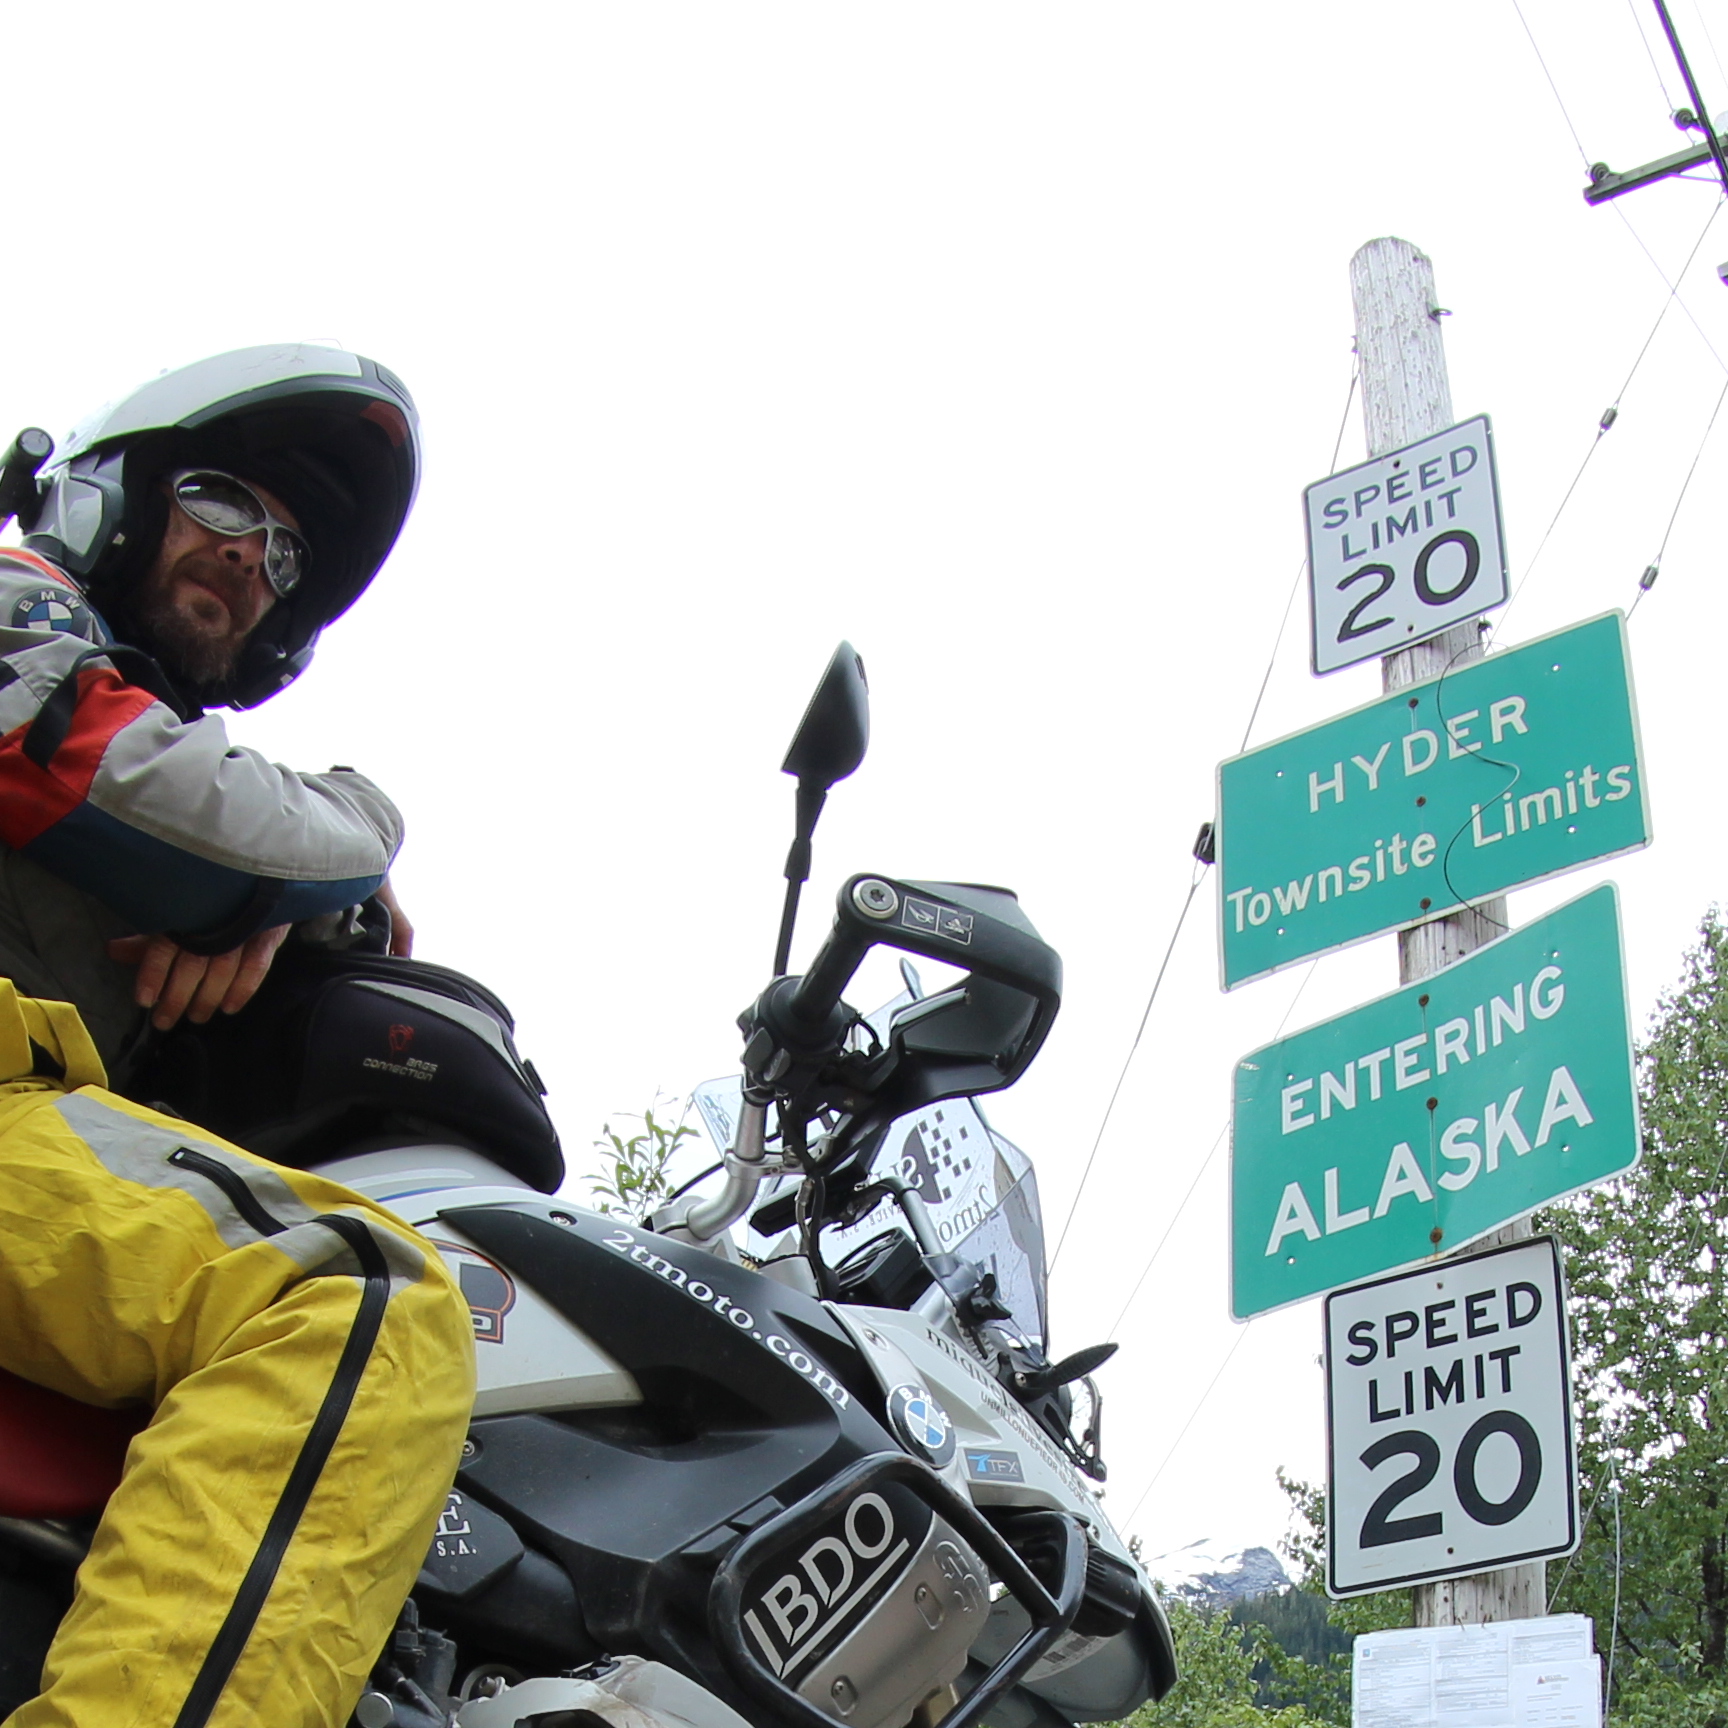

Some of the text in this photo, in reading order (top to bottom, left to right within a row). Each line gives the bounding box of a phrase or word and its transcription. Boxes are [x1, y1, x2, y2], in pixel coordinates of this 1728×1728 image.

[1322, 444, 1479, 530] SPEED
[1341, 486, 1462, 563] LIMIT
[18, 590, 81, 613] BMW
[1336, 529, 1480, 644] 20
[1308, 695, 1528, 813] HYDER
[1226, 763, 1632, 934] Townsite Limits
[362, 1057, 434, 1082] CONNECTION
[406, 1056, 439, 1073] BAGS
[1281, 964, 1566, 1136] ENTERING
[1264, 1064, 1594, 1257] ALASKA
[602, 1229, 852, 1411] 2tmoto.com
[1344, 1281, 1542, 1367] SPEED
[898, 1387, 954, 1430] BMW
[1369, 1345, 1521, 1424] LIMIT
[1358, 1409, 1543, 1549] 20
